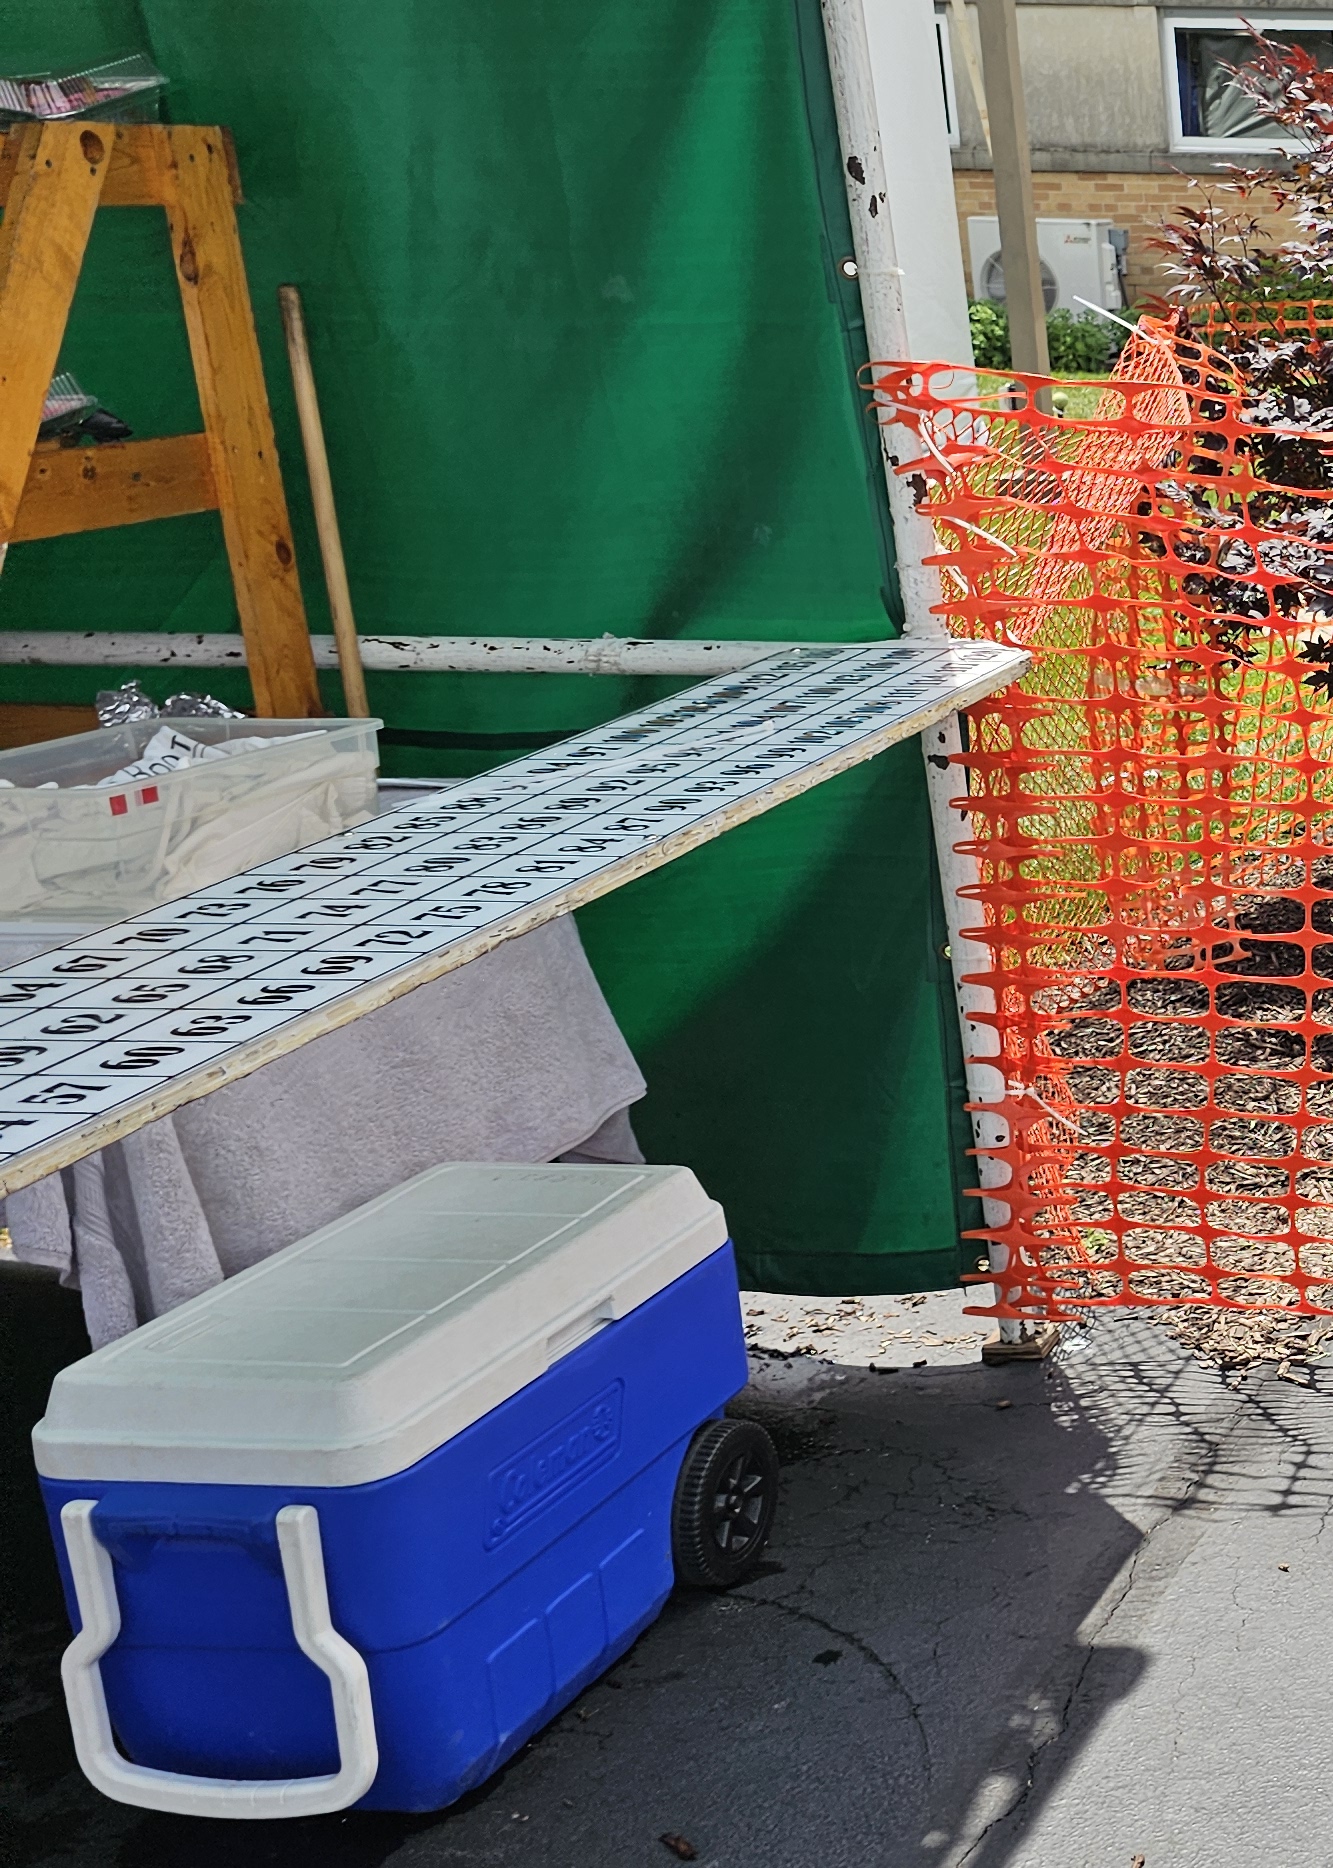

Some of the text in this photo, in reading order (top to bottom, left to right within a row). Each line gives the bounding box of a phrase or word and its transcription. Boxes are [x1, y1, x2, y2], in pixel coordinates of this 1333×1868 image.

[770, 661, 816, 670] 115
[853, 663, 900, 671] 116
[739, 673, 790, 684] 112
[826, 675, 872, 684] 113
[796, 688, 845, 698] 110
[881, 689, 929, 698] 111
[764, 701, 816, 712] 107
[639, 713, 696, 727] 103
[818, 715, 873, 728] 105
[786, 730, 845, 744] 102
[566, 746, 623, 758] 97
[754, 747, 807, 759] 99
[527, 761, 587, 774] 94
[626, 763, 681, 774] 95
[720, 763, 775, 776] 96
[585, 779, 645, 792] 92
[683, 781, 740, 793] 93
[440, 796, 502, 810] 88
[544, 797, 601, 810] 89
[644, 798, 702, 812] 90
[394, 816, 456, 829] 85
[499, 816, 562, 830] 86
[603, 817, 664, 831] 87
[343, 836, 412, 850] 82
[453, 836, 518, 850] 83
[558, 838, 625, 852] 84
[289, 857, 357, 871] 79
[403, 857, 471, 872] 80
[515, 860, 580, 873] 81
[235, 879, 306, 894] 76
[348, 880, 422, 895] 77
[461, 881, 531, 896] 78
[174, 903, 251, 918] 73
[295, 905, 371, 919] 74
[410, 905, 482, 920] 75
[113, 928, 191, 946] 70
[238, 931, 314, 944] 71
[353, 930, 434, 947] 72
[52, 955, 129, 972] 67
[178, 955, 255, 974] 68
[300, 955, 373, 975] 69
[0, 983, 66, 1002] 64
[112, 984, 190, 1003] 65
[237, 984, 316, 1005] 66
[40, 1014, 128, 1035] 62
[170, 1015, 252, 1036] 63
[100, 1046, 185, 1070] 60
[17, 1083, 112, 1105] 57
